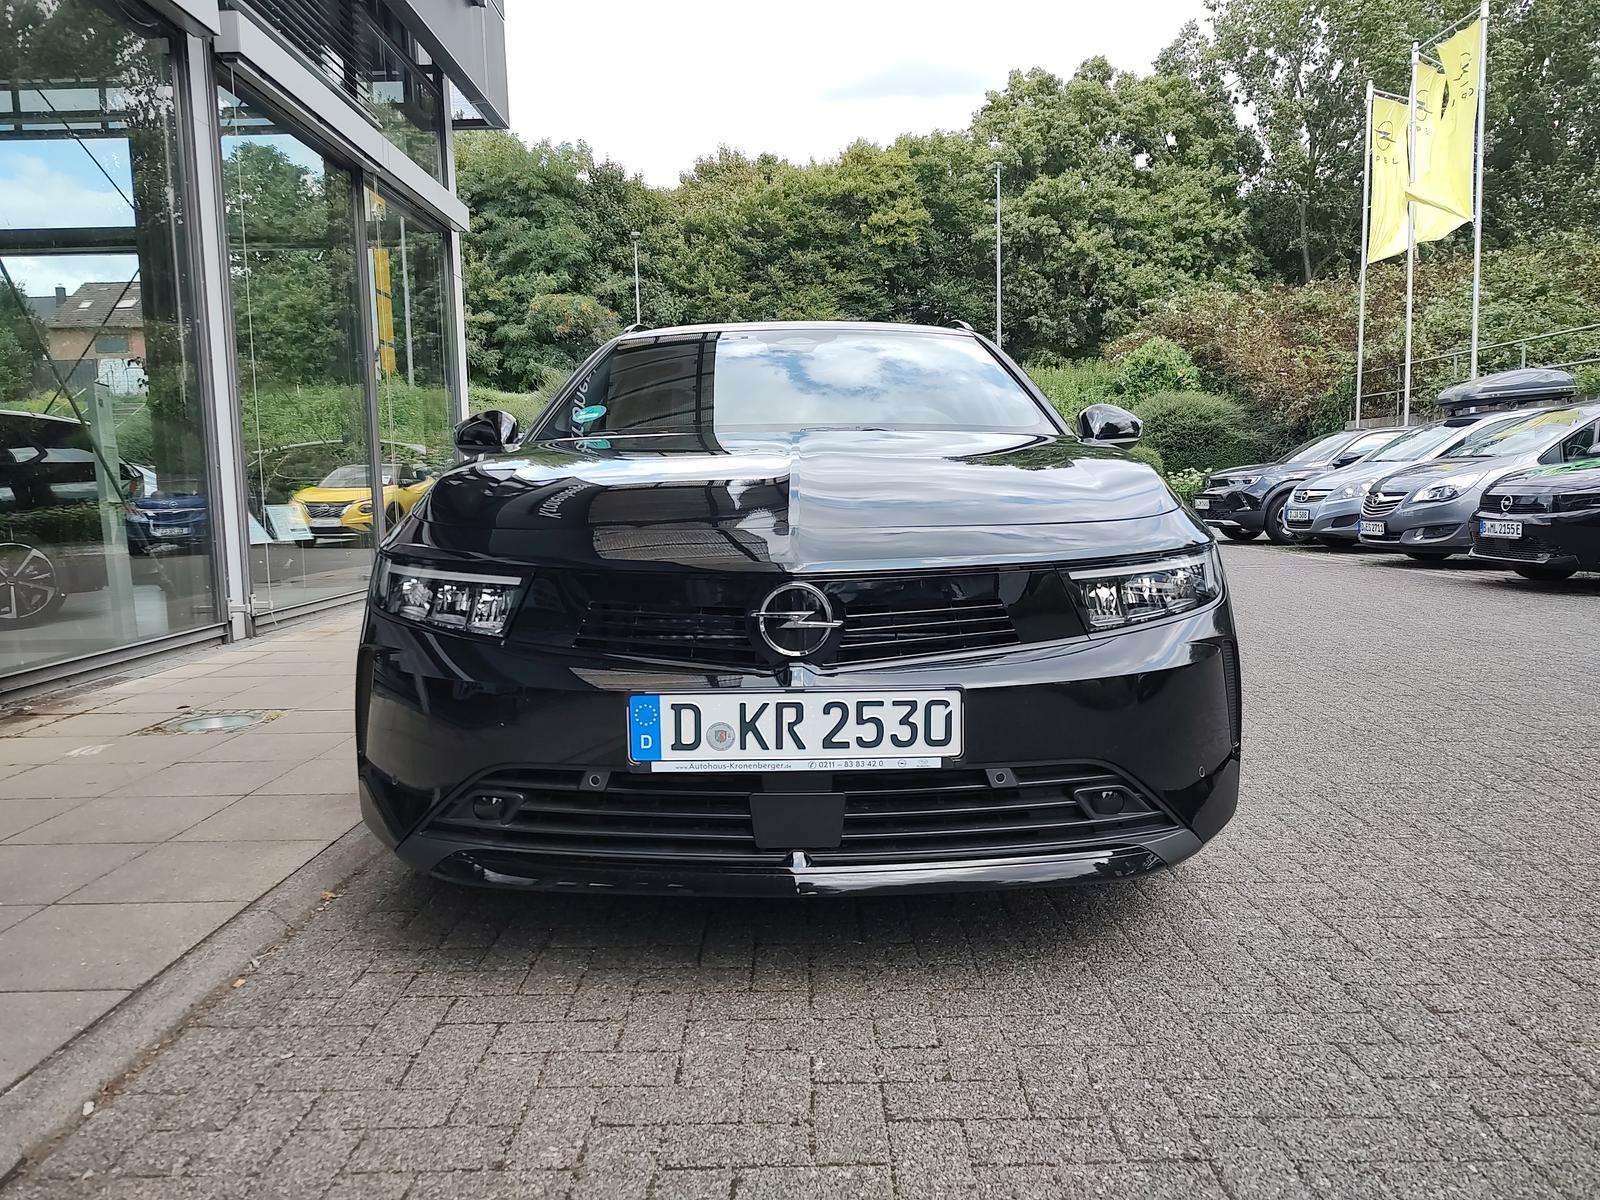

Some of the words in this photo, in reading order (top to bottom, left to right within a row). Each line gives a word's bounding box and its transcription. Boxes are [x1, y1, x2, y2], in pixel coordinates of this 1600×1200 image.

[640, 734, 652, 749] D
[671, 703, 702, 751] D
[739, 702, 806, 751] KR
[822, 699, 953, 749] 2530
